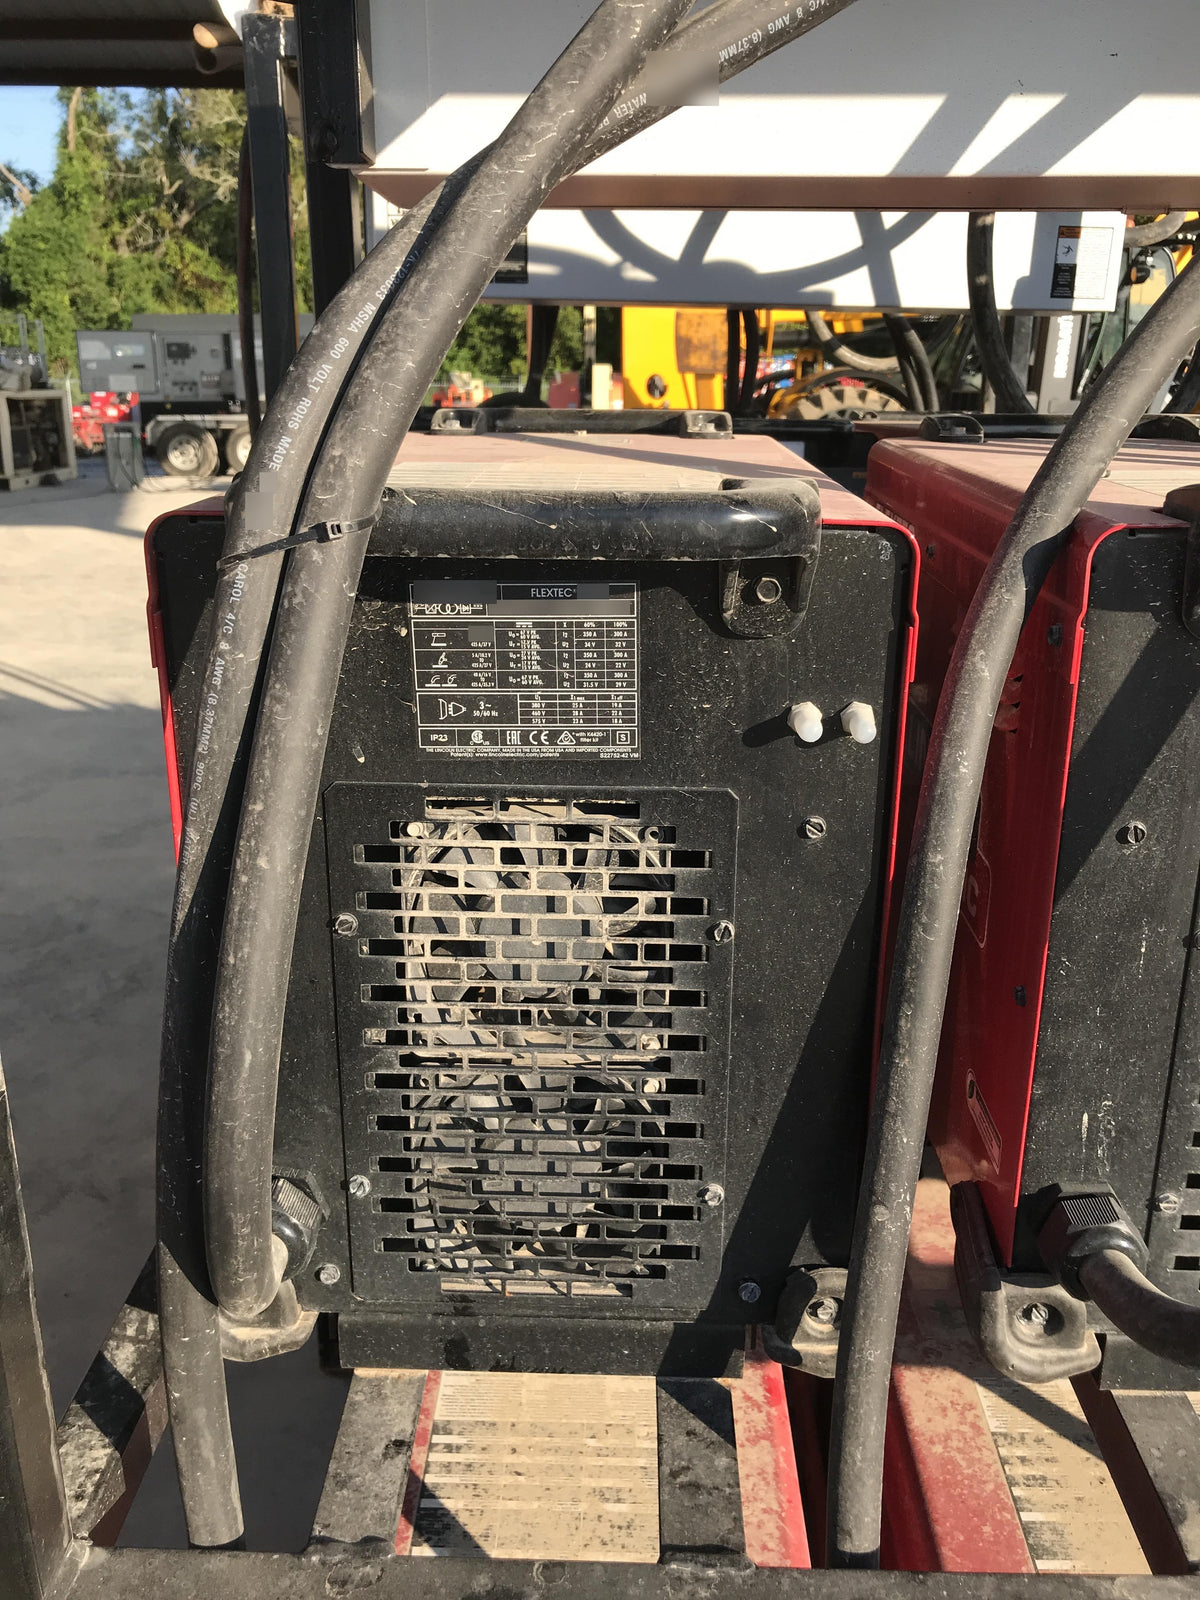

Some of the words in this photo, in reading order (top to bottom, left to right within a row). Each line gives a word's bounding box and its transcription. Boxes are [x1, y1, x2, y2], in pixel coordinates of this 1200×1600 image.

[768, 14, 790, 34] AWG
[796, 6, 804, 18] 8
[348, 302, 376, 333] MSHA
[330, 337, 350, 359] 600
[308, 364, 333, 393] VOLT
[288, 397, 312, 430] ROHS
[268, 434, 292, 472] MADE
[230, 562, 248, 604] CAROL
[530, 588, 574, 598] FLEXTEC
[222, 612, 236, 636] 4/C
[219, 642, 230, 650] 8
[210, 657, 226, 686] AWG
[200, 693, 220, 755] (8.37MM2)
[188, 797, 200, 820] (UL)
[182, 826, 194, 866] WATER
